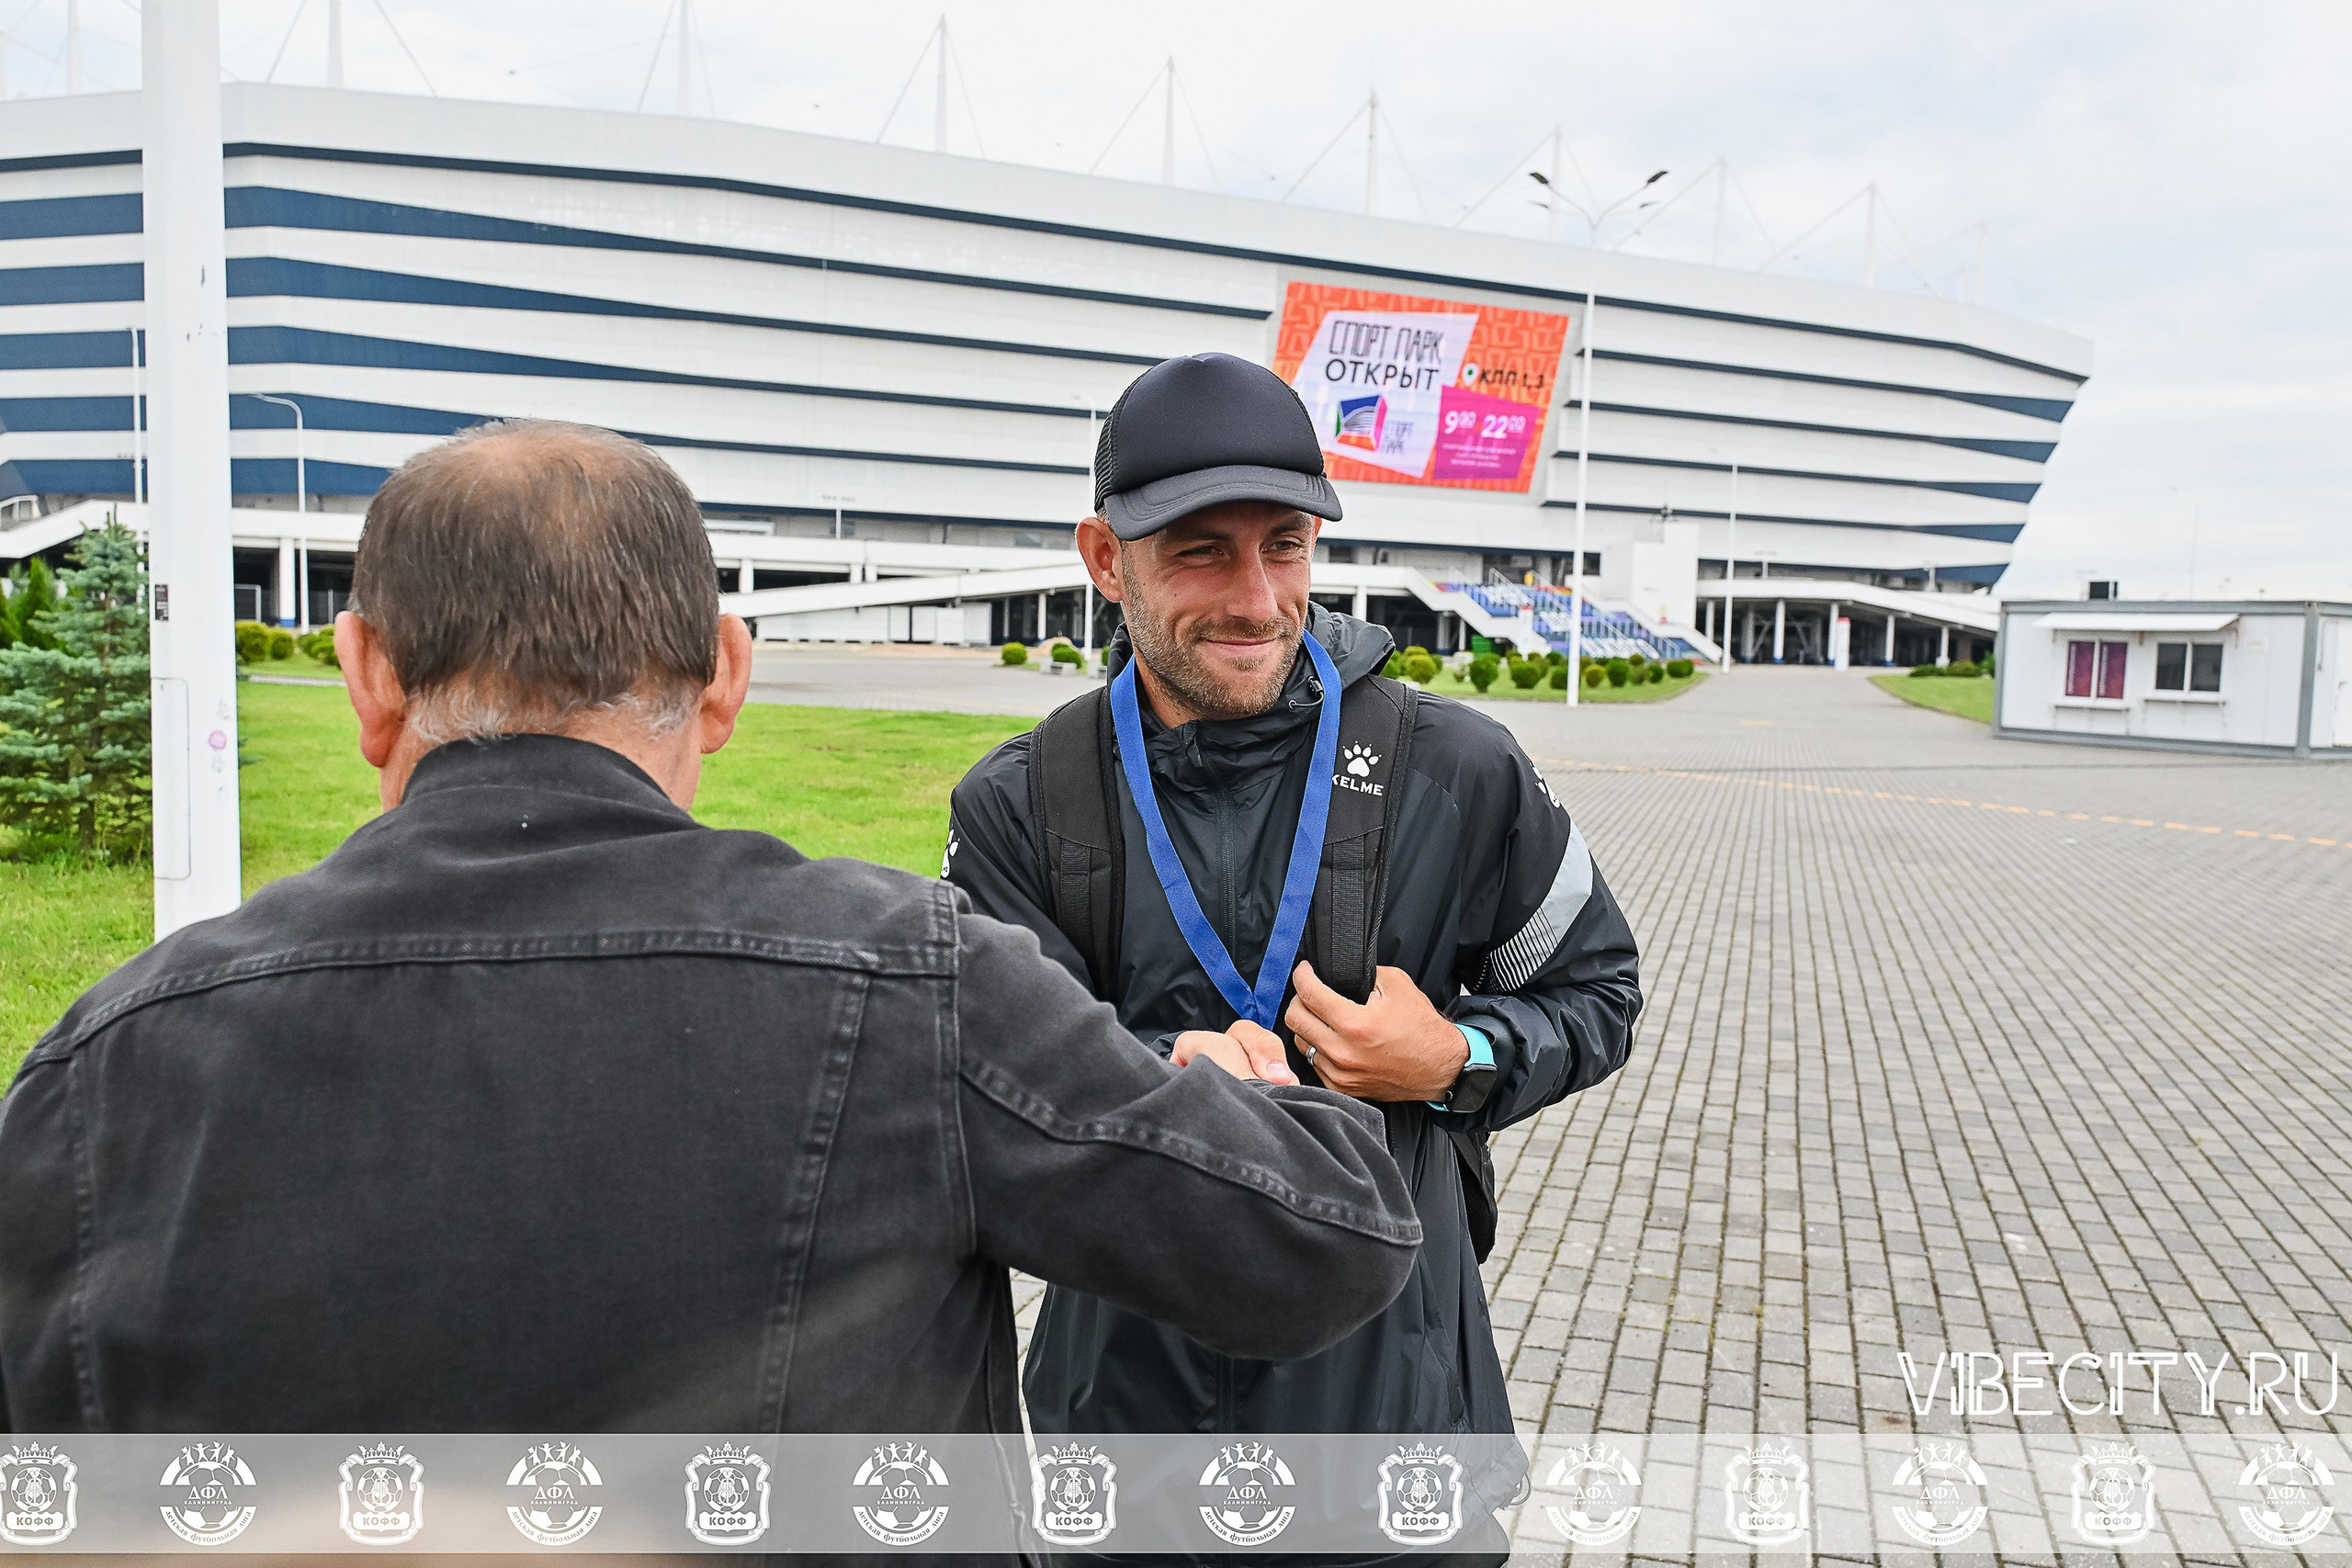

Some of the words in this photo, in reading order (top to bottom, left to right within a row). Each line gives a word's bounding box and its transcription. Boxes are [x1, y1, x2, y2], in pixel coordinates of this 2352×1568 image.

[1329, 321, 1392, 359] СПОРТ
[1393, 328, 1443, 365] ПАРК
[1326, 358, 1439, 390] ОТКРЫТ
[1479, 369, 1517, 386] КПП
[1332, 773, 1384, 796] KELME
